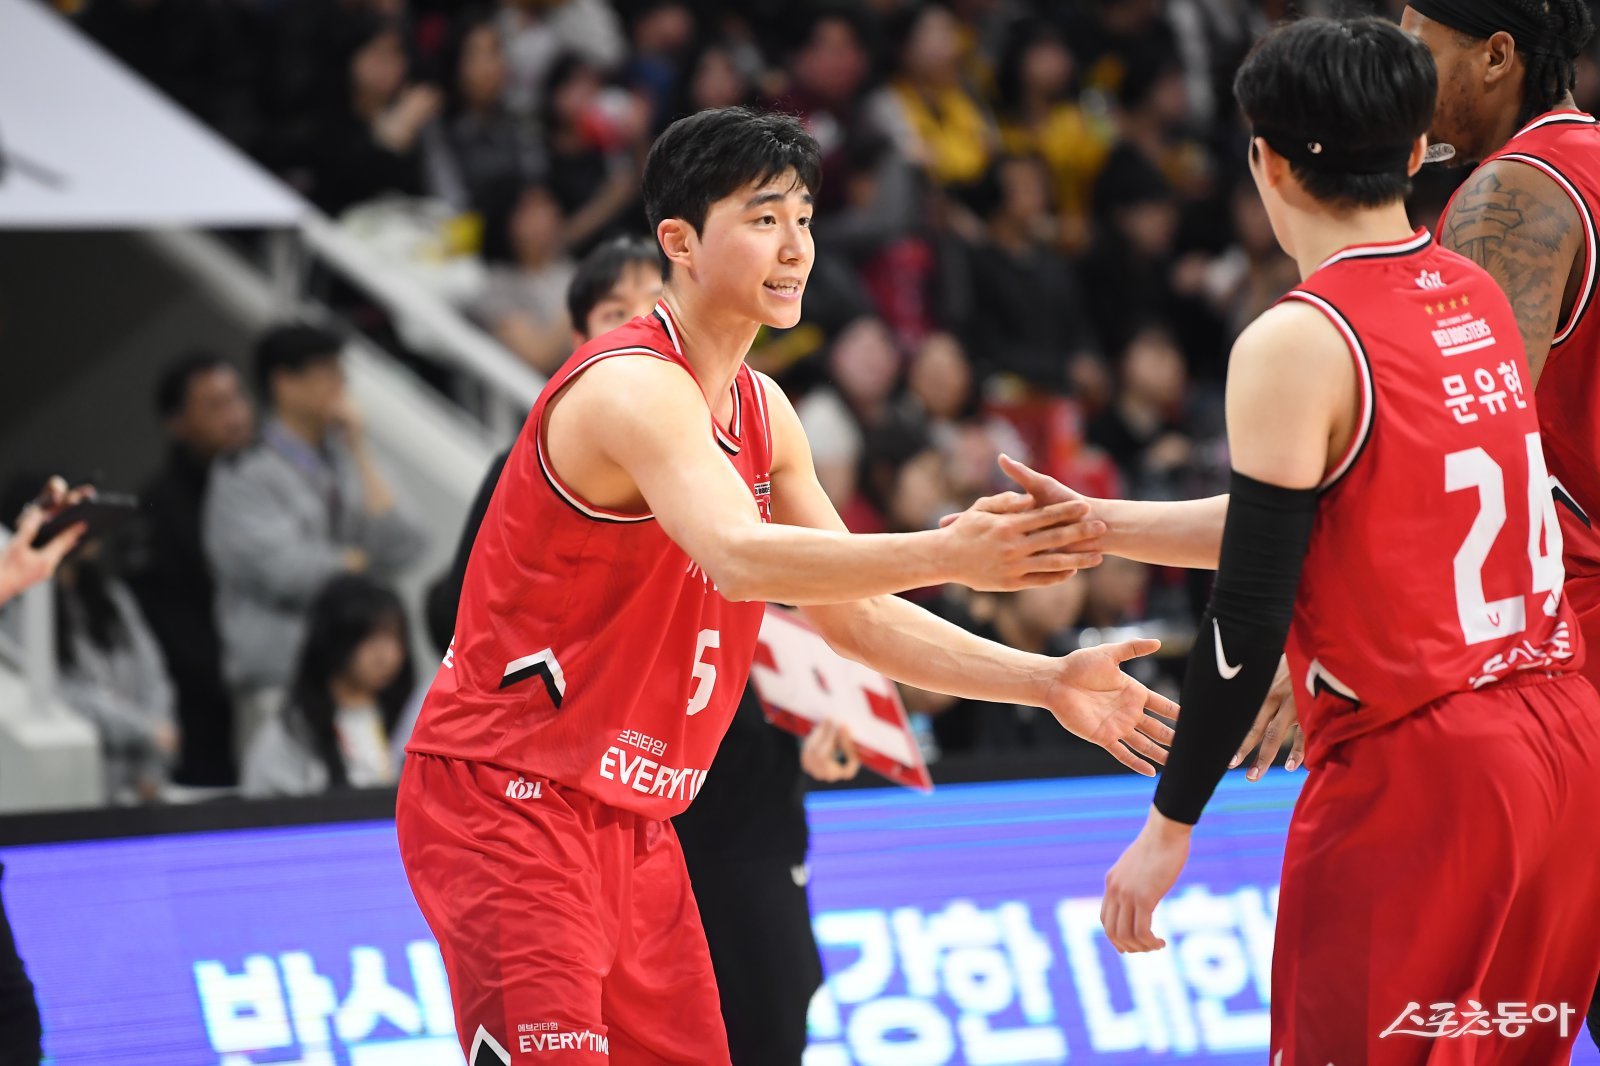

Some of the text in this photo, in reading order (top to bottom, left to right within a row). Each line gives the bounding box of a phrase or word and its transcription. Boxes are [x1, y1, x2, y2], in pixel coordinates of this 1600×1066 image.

[1441, 359, 1527, 424] 문유현
[1444, 431, 1565, 646] 24
[686, 628, 720, 716] 5
[801, 898, 1070, 1066] 강한
[1056, 883, 1280, 1056] 대한
[517, 1022, 558, 1032] 에브리타임
